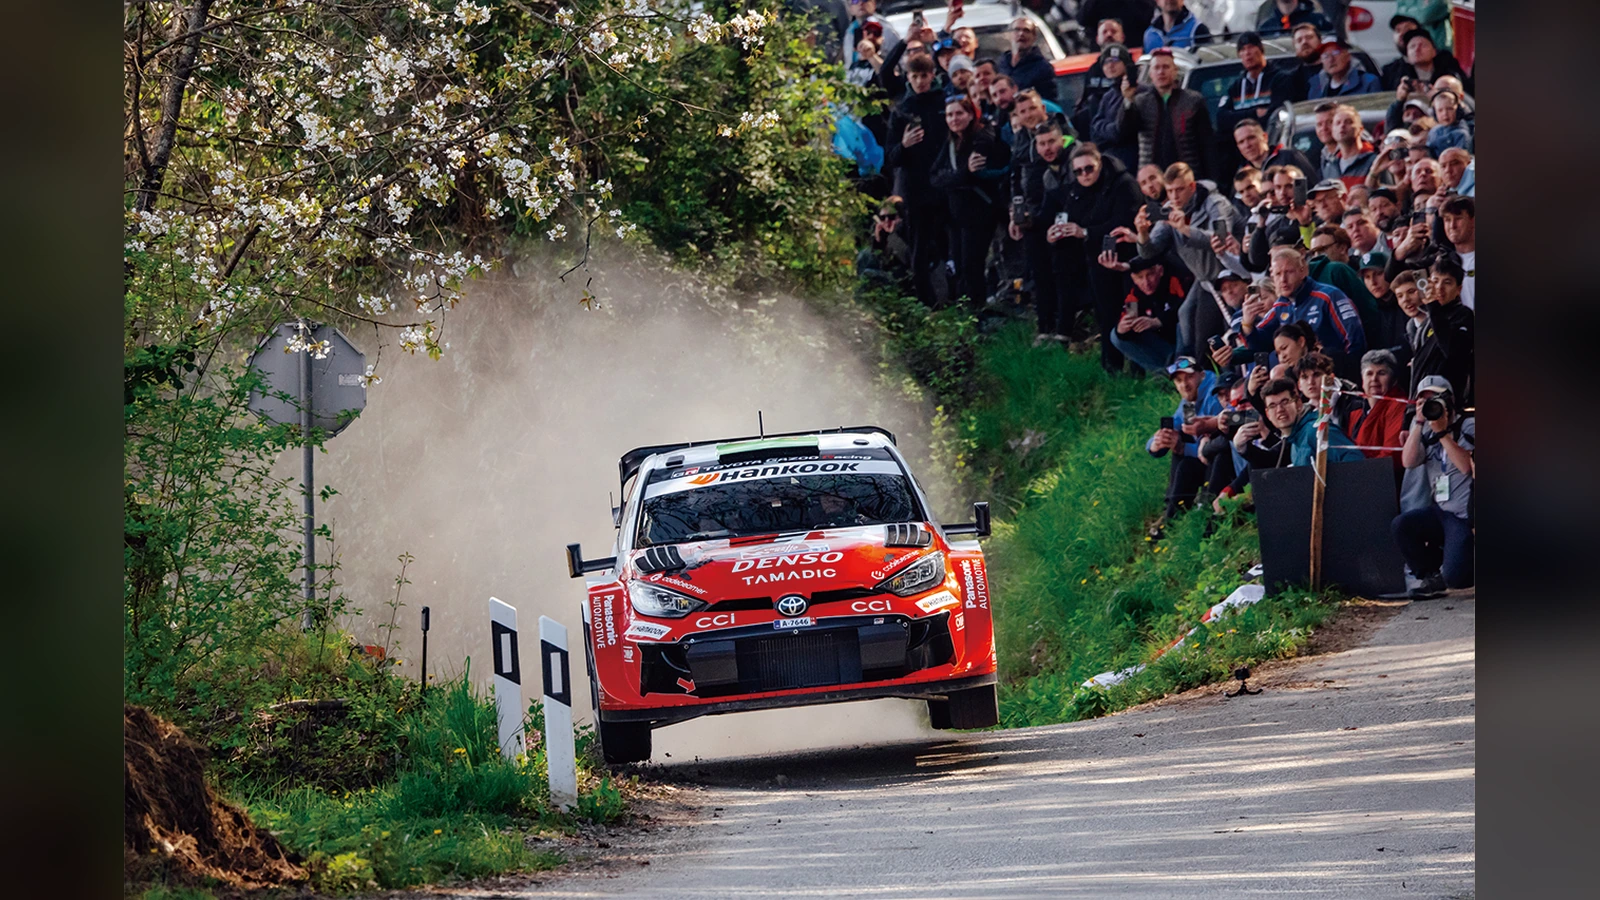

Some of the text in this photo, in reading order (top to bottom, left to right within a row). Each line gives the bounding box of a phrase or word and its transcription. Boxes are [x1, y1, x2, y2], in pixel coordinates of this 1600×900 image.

[703, 460, 762, 472] TOYOTA
[765, 455, 819, 463] GAZOO
[731, 552, 844, 573] DENSO
[742, 568, 836, 585] TAMADIC
[960, 560, 977, 609] Panasonic
[972, 559, 988, 609] AUTOMOTIVE
[593, 596, 606, 649] AUTOMOTIVE
[604, 595, 618, 646] Panasonic
